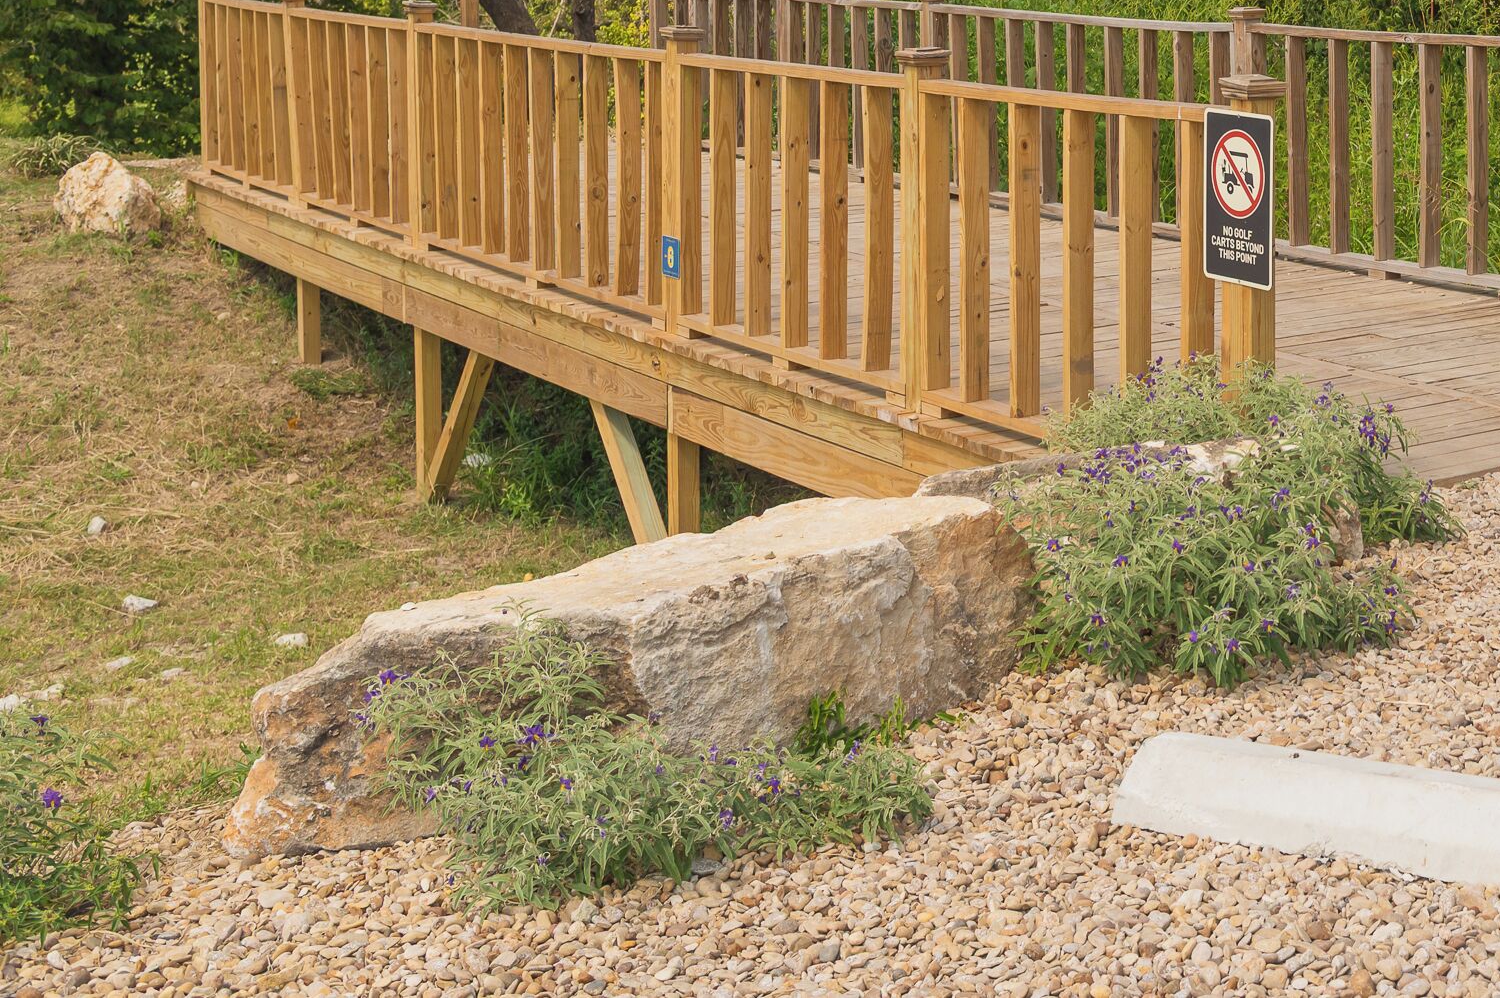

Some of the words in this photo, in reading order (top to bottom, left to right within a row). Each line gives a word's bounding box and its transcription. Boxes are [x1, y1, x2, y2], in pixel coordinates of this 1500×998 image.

[1222, 225, 1233, 236] NO
[1234, 228, 1252, 240] GOLF
[1211, 234, 1235, 249] CARTS
[1236, 239, 1264, 255] BEYOND
[1218, 248, 1235, 261] THIS
[1236, 251, 1257, 265] POINT
